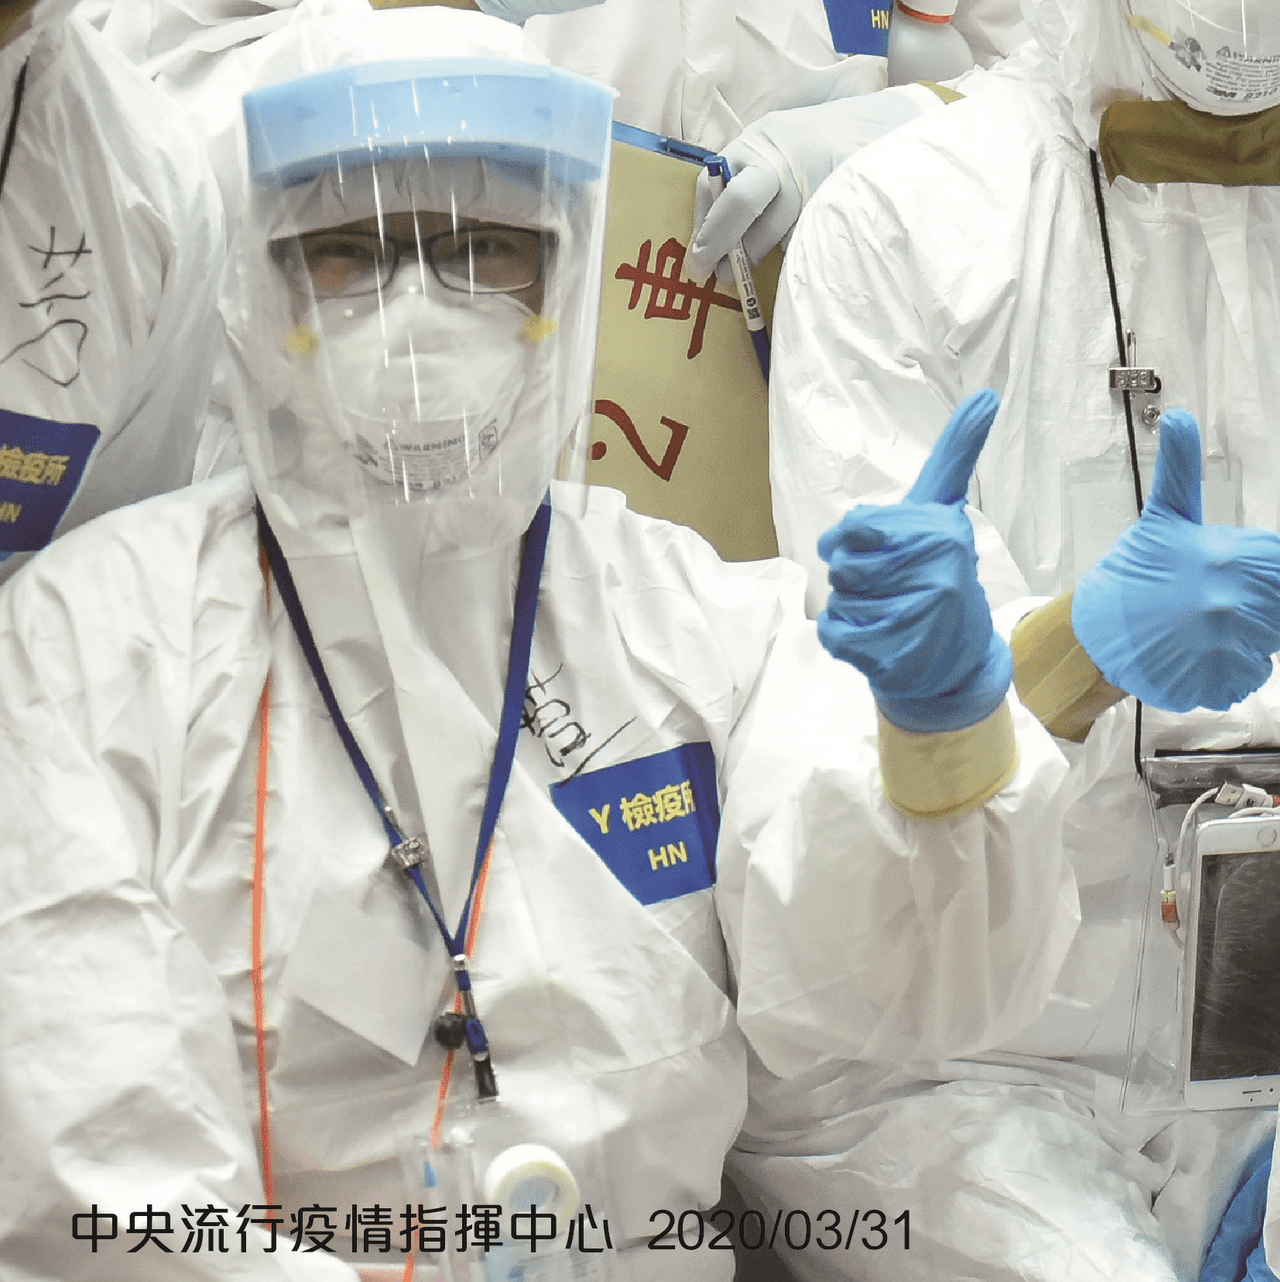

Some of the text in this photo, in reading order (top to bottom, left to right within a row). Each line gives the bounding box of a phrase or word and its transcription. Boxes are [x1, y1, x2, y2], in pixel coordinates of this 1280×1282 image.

[869, 8, 891, 31] HN
[588, 804, 611, 835] Y
[647, 840, 689, 872] HN
